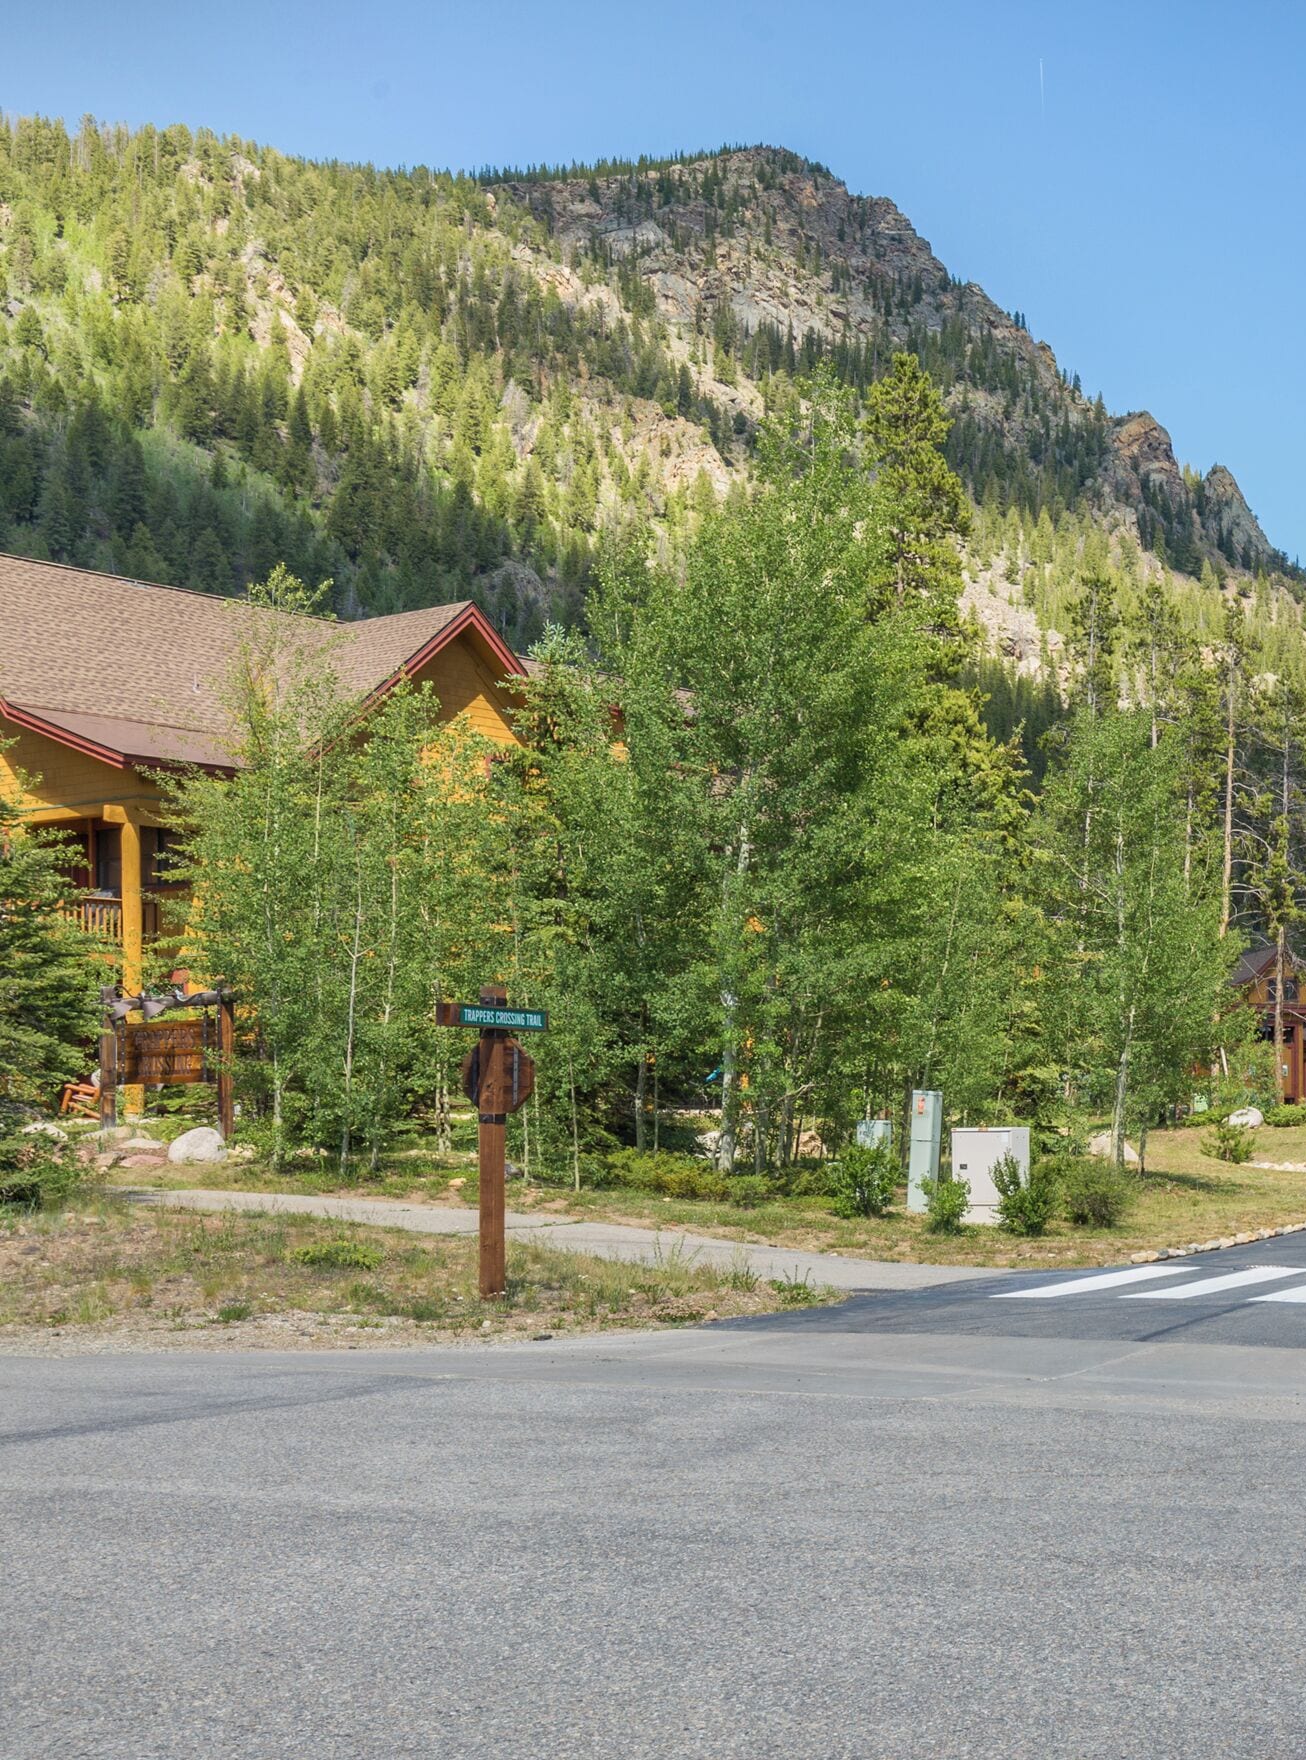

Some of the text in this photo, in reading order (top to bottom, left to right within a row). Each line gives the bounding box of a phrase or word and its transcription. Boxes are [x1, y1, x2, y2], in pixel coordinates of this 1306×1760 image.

[464, 1009, 543, 1027] TRAPPERS CROSSING TRAIL
